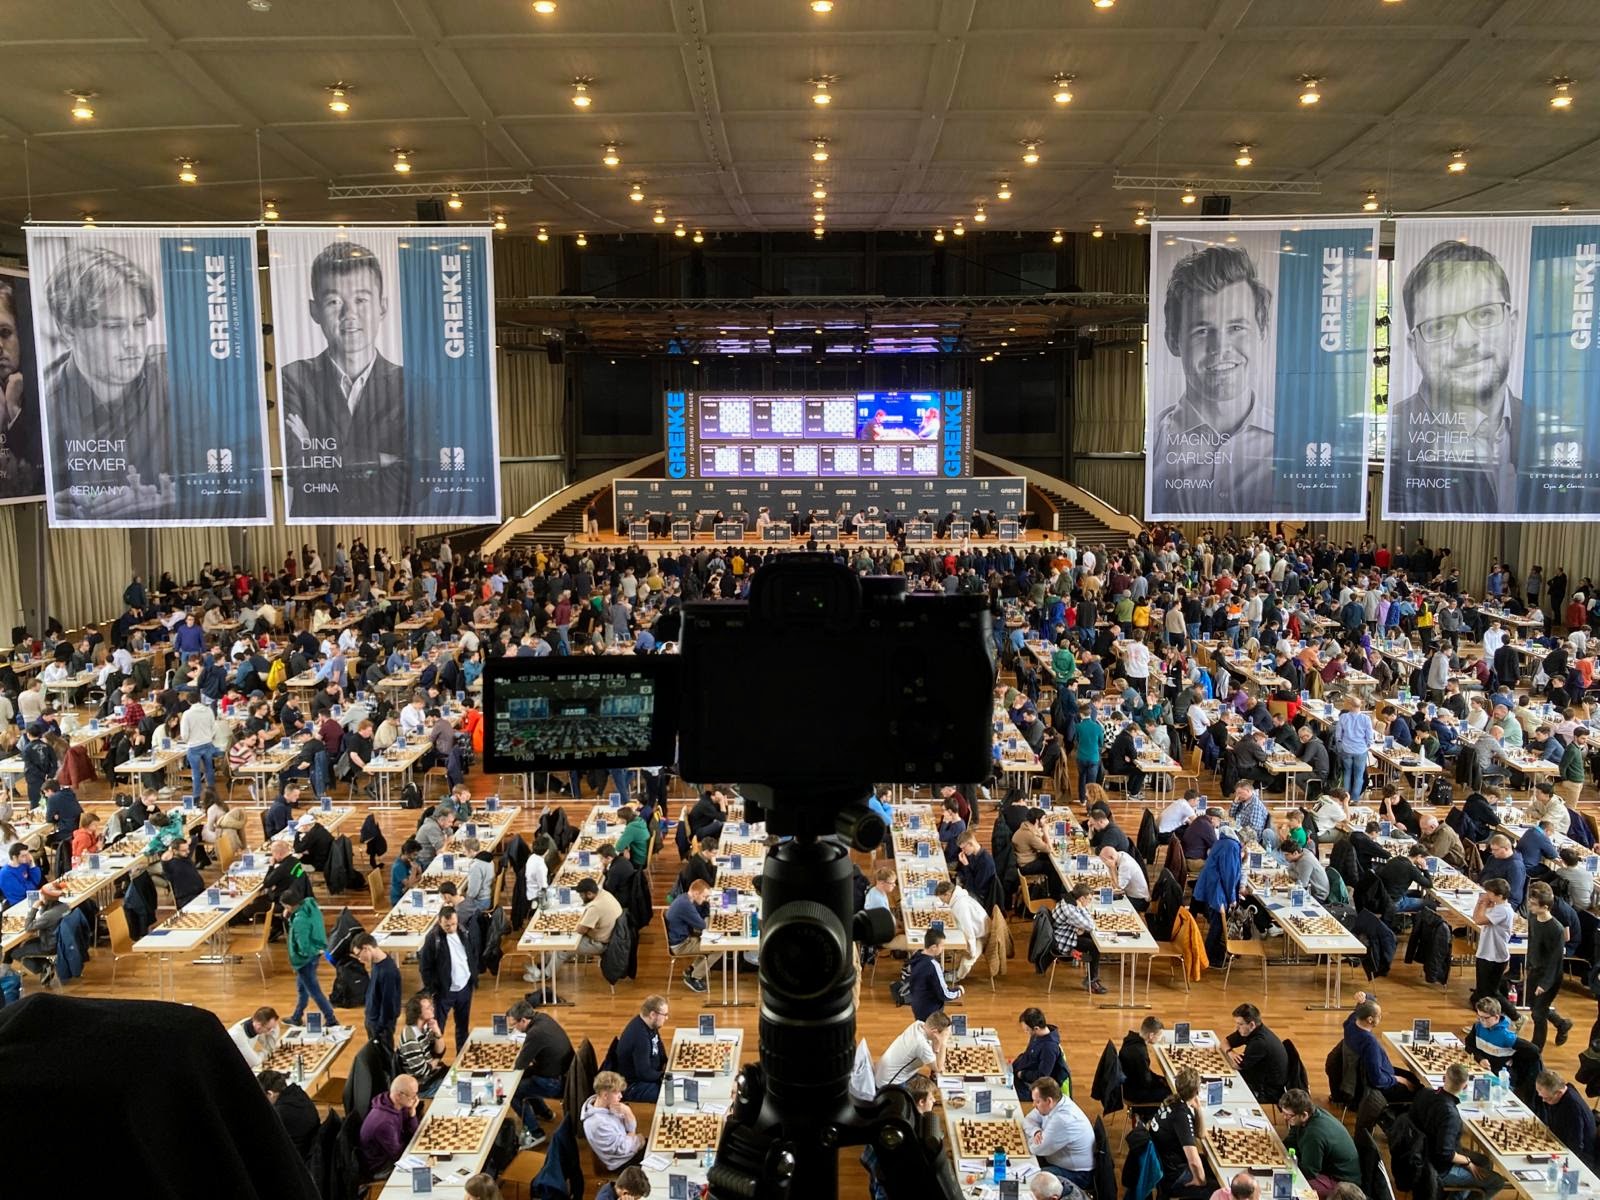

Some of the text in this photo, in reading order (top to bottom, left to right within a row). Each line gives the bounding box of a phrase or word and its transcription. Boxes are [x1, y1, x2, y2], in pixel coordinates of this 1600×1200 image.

[1320, 247, 1344, 352] GRENKE
[1571, 244, 1597, 350] GRENKE
[205, 256, 231, 360] GRENKE
[441, 255, 465, 358] GRENKE
[1409, 412, 1467, 425] MAXIME
[667, 392, 687, 479] GRENKE
[943, 390, 963, 477] GRENKE
[1166, 432, 1232, 446] MAGNUS
[65, 439, 126, 453] VINCENT
[301, 437, 337, 450] DING
[302, 456, 343, 469] LIREN
[1166, 451, 1233, 465] CARLSEN
[1407, 449, 1475, 463] LAGRAVE
[67, 458, 126, 471] KEYMER
[69, 485, 125, 496] GERMANY
[303, 482, 340, 494] CHINA
[1165, 479, 1216, 490] NORWAY
[1406, 478, 1452, 489] FRANCE
